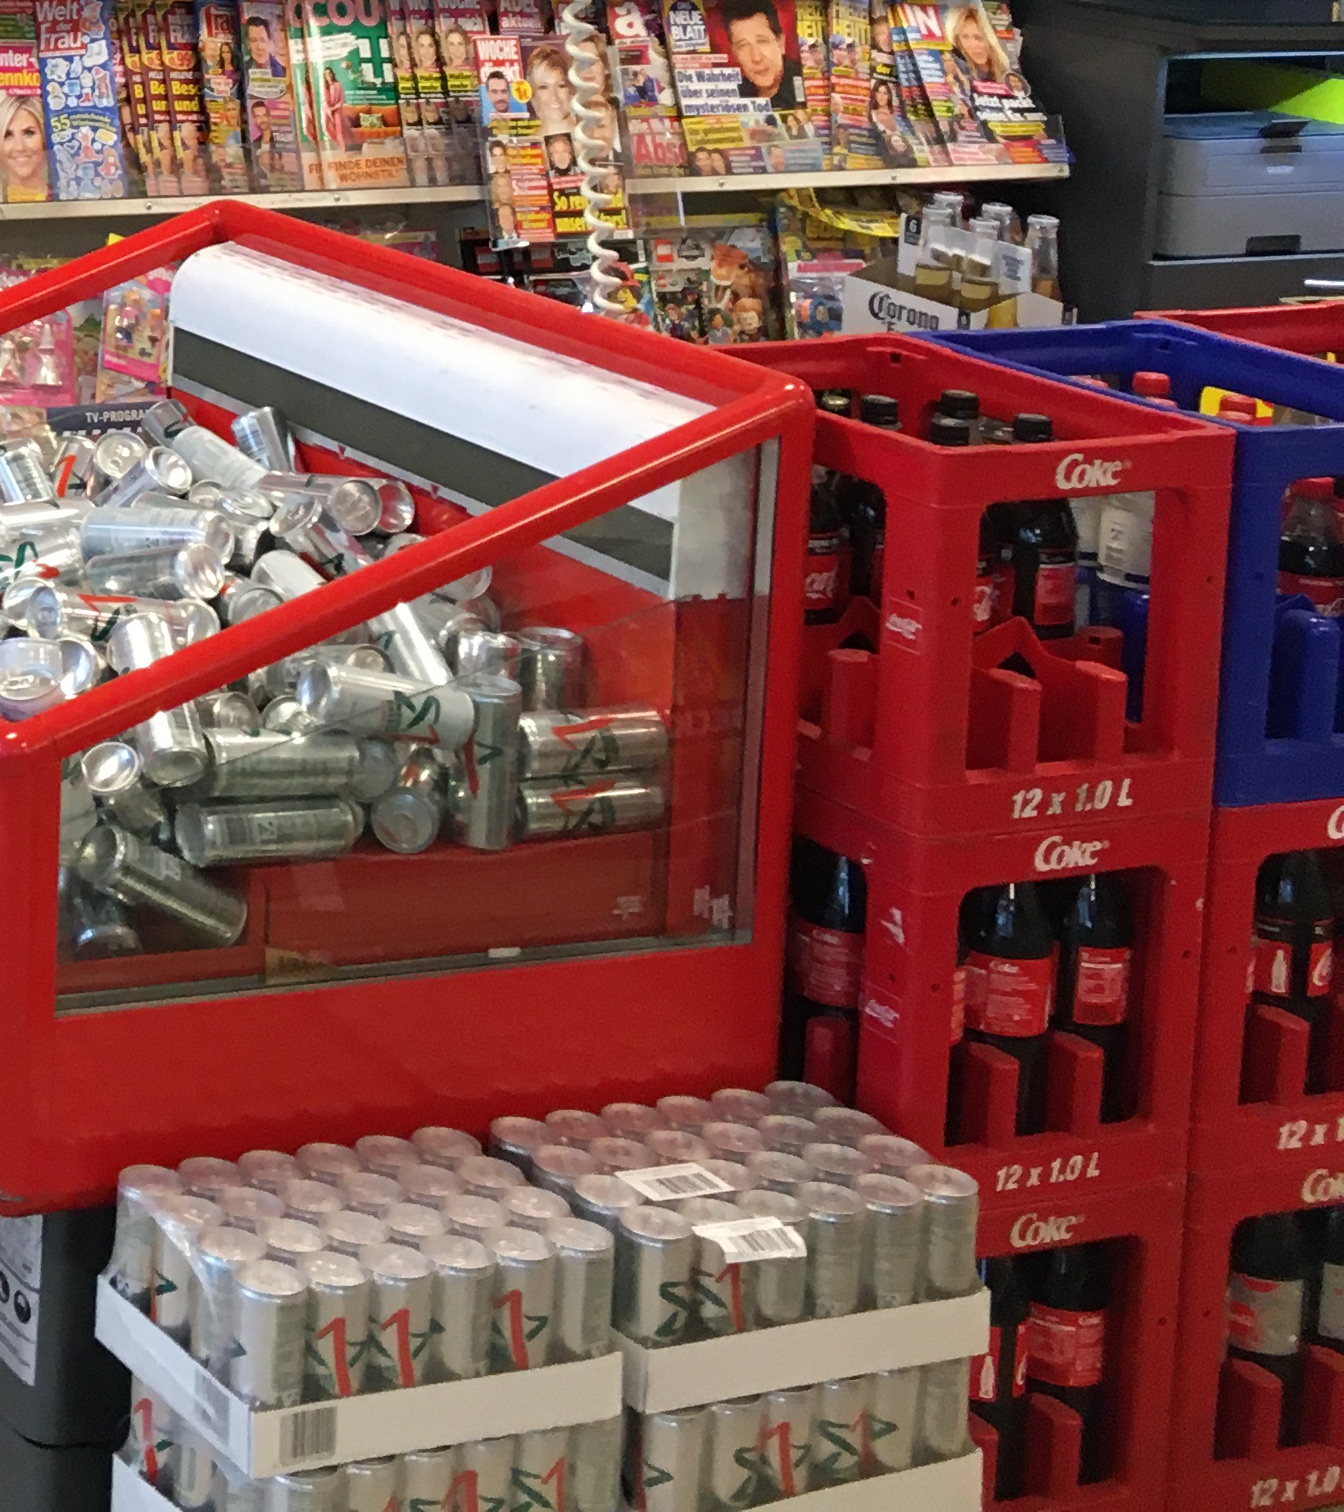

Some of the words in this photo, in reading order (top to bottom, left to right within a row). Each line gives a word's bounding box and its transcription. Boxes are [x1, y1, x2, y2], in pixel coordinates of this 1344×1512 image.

[35, 0, 79, 23] Welt
[668, 9, 703, 27] NEUE
[39, 29, 82, 54] Frau
[670, 24, 706, 41] BLATT
[477, 39, 518, 61] WOCHE
[677, 70, 694, 85] Die
[695, 69, 740, 86] Wahrheit
[706, 84, 737, 99] seinen
[749, 98, 772, 113] Tod
[869, 292, 940, 331] Corona
[1056, 452, 1123, 489] Coke
[1012, 787, 1040, 819] 12
[1046, 790, 1065, 814] x
[1076, 780, 1113, 813] 1.0
[1115, 777, 1134, 807] L
[1034, 834, 1104, 872] Coke
[1276, 1120, 1303, 1150] 12
[1309, 1122, 1328, 1146] x
[996, 1164, 1022, 1192] 12
[1026, 1165, 1042, 1188] x
[1049, 1155, 1081, 1185] 1.0
[1084, 1151, 1101, 1180] L
[1010, 1212, 1078, 1248] Coke
[1251, 1476, 1275, 1508] 12
[1279, 1478, 1298, 1502] x
[1306, 1465, 1341, 1496] 1.0
